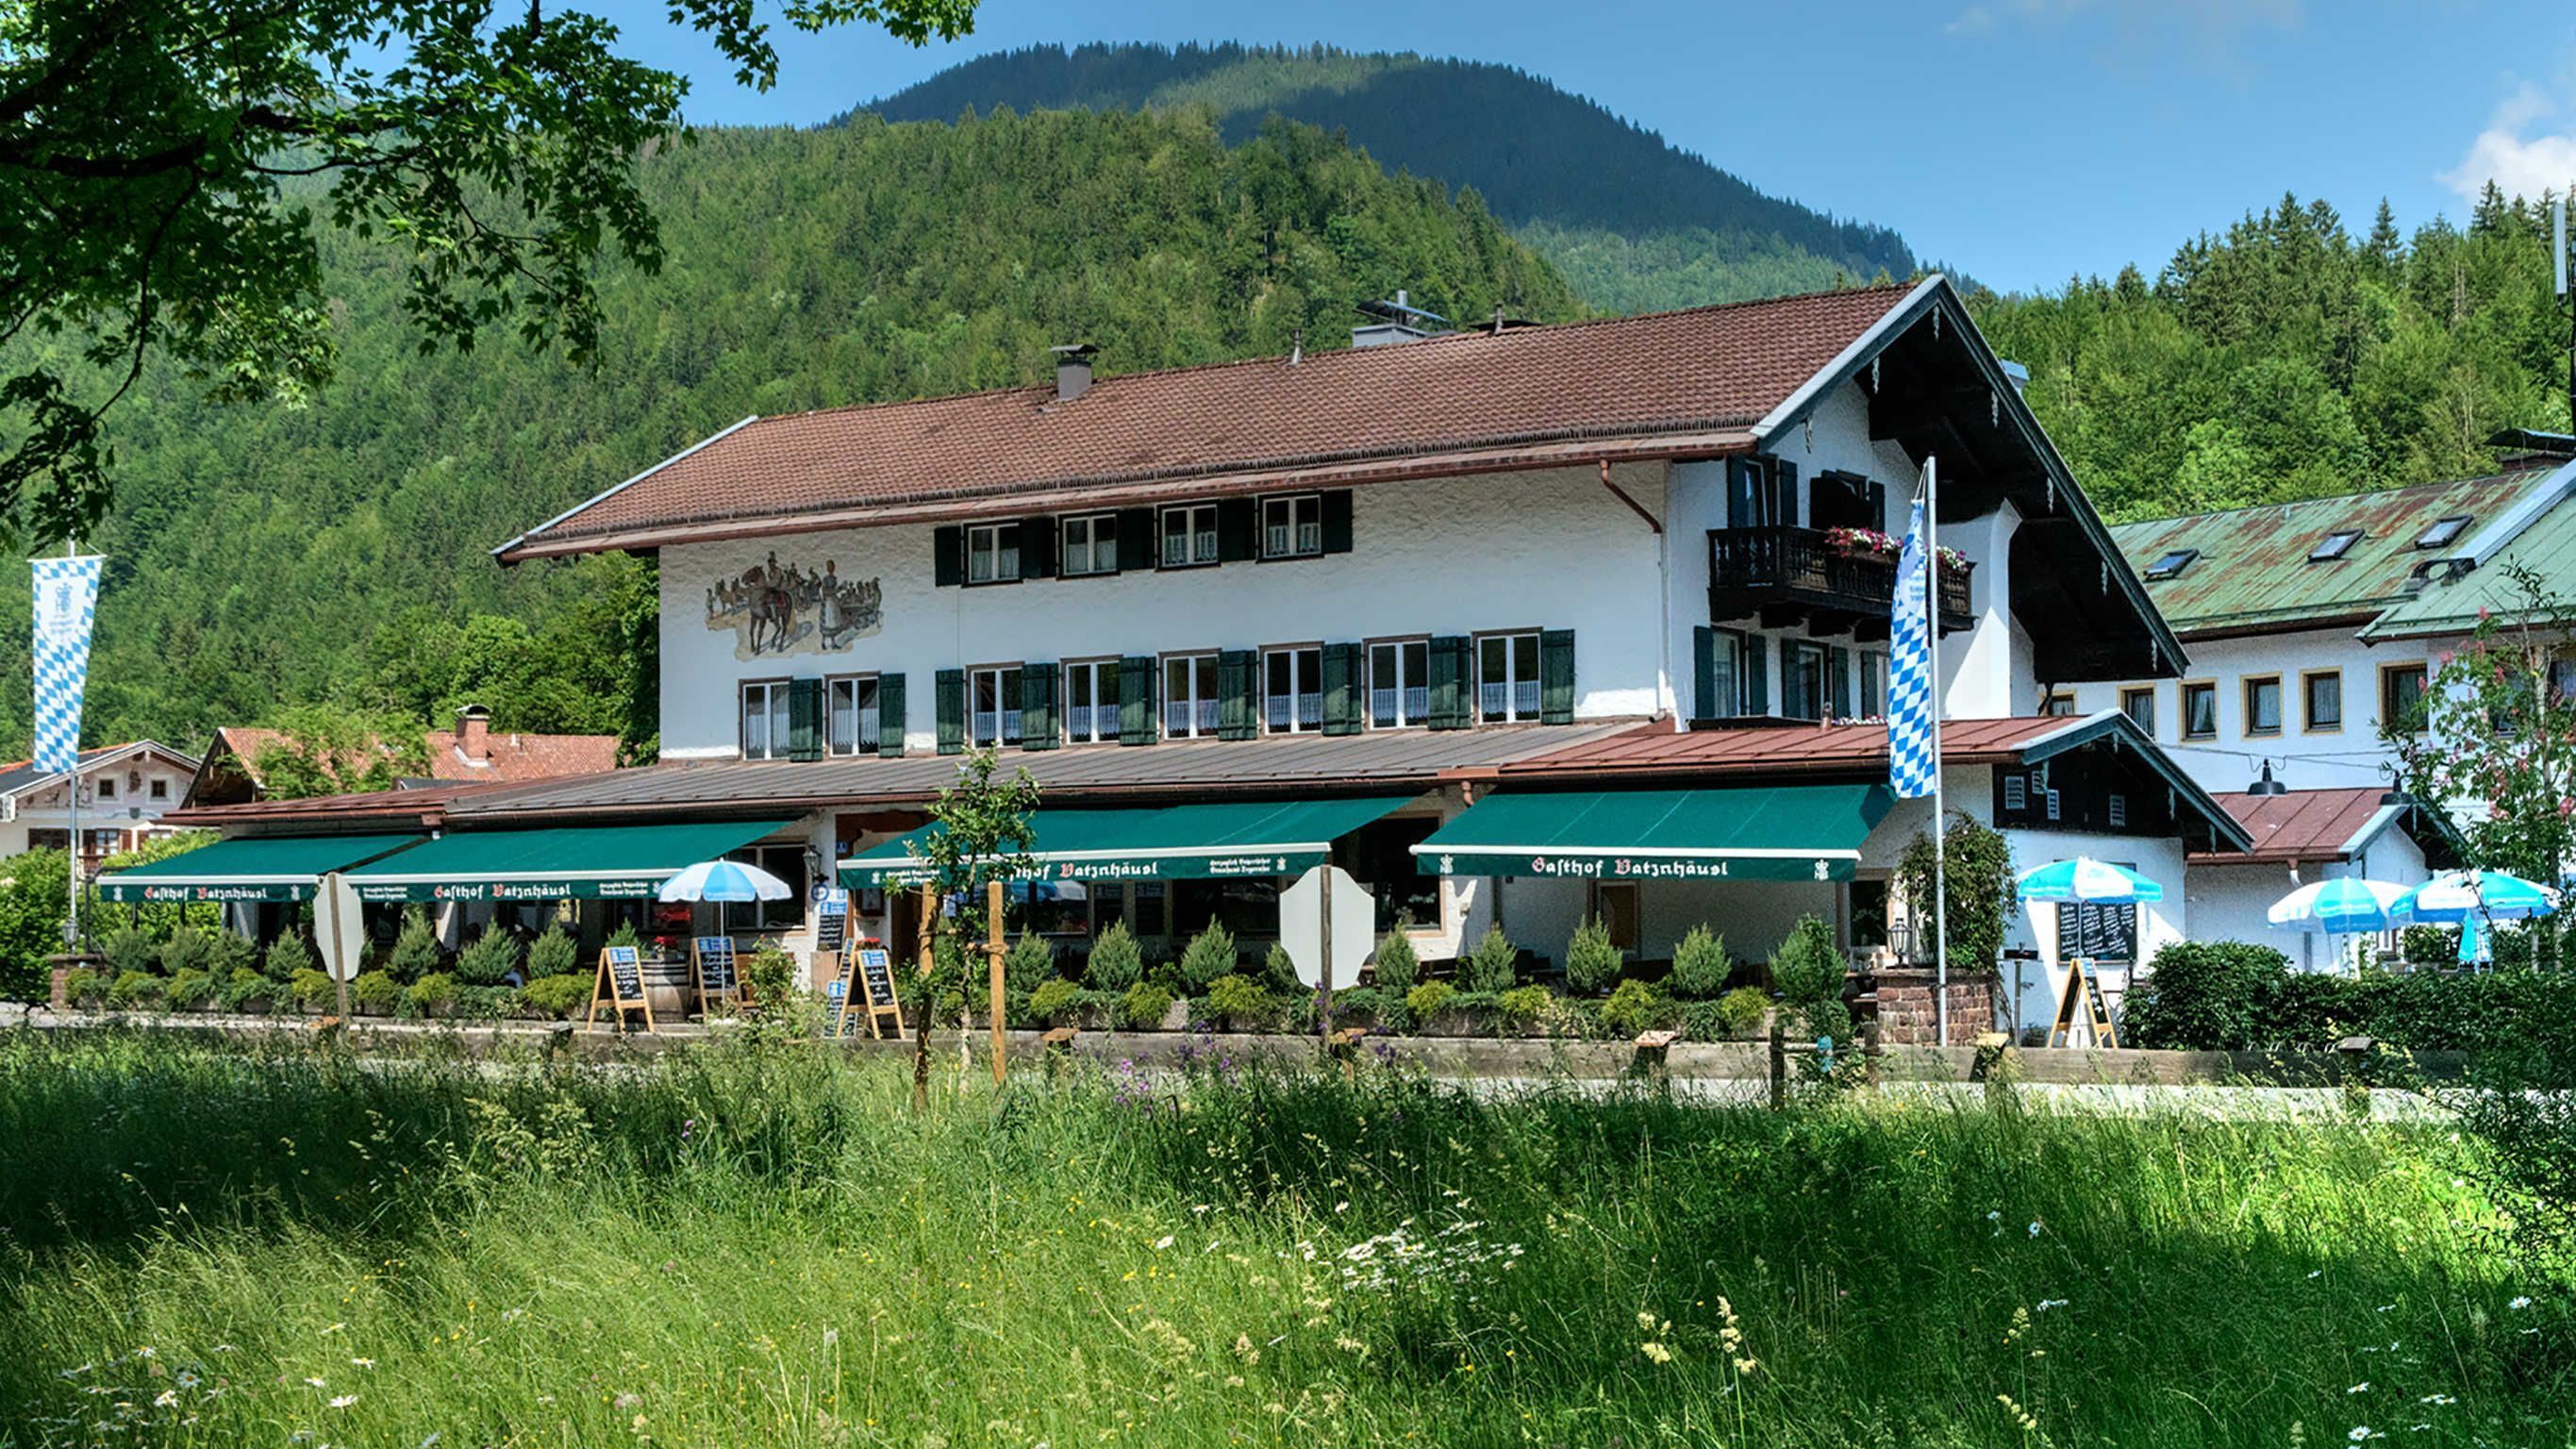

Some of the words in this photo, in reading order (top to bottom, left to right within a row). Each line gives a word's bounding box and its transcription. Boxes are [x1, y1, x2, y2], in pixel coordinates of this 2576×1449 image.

[1531, 856, 1604, 877] Gasthof
[144, 886, 189, 900] Gasthof
[434, 885, 484, 899] Gasthof
